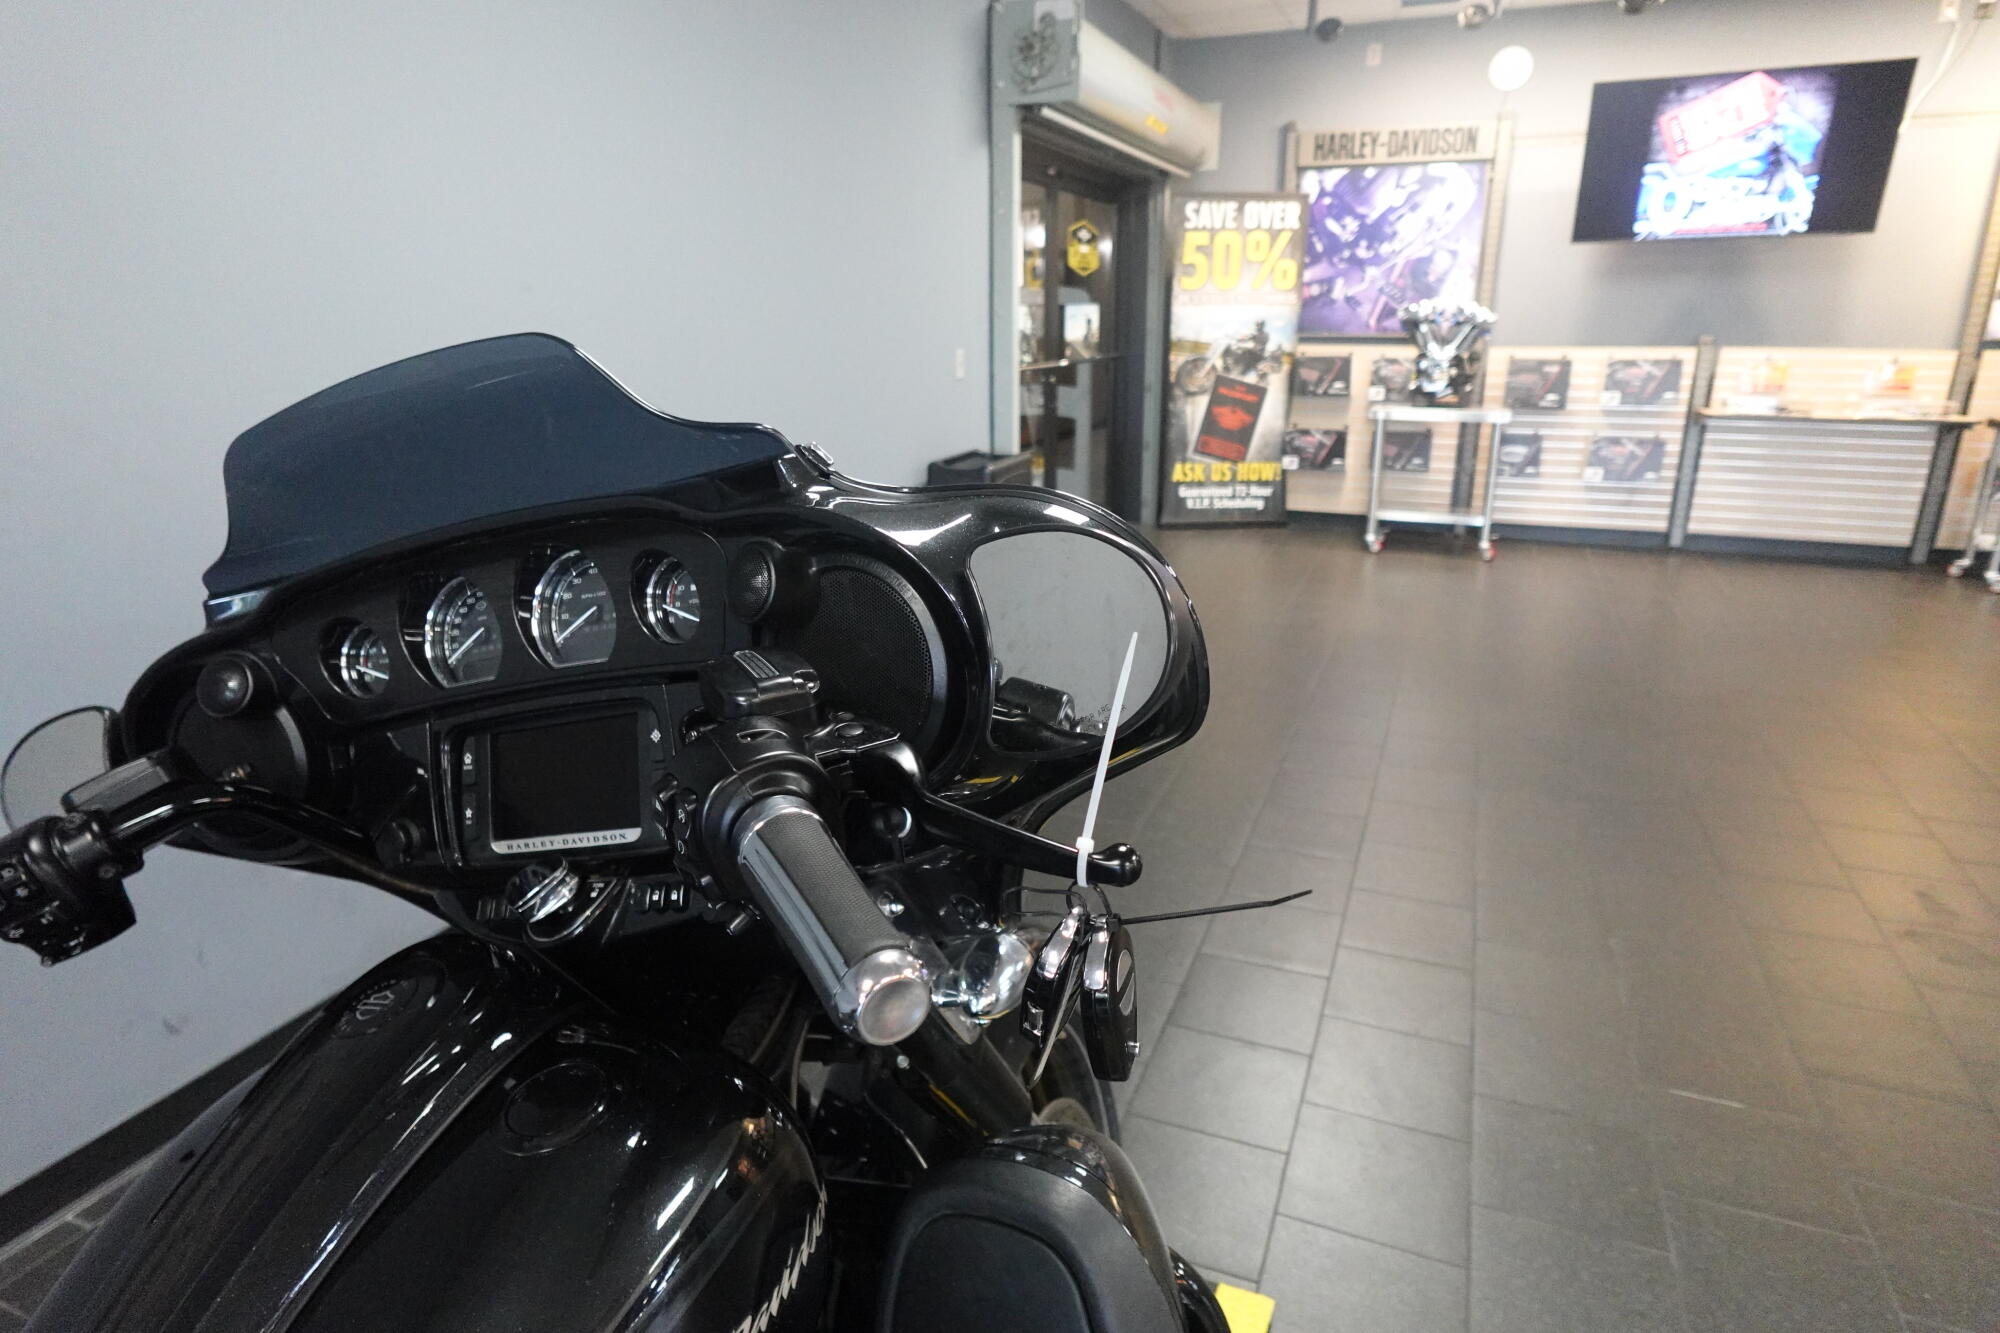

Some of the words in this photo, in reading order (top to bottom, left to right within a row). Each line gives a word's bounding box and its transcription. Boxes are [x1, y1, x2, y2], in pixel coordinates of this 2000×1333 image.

[1313, 125, 1479, 161] HARLEY-DAVIDSON
[1183, 200, 1240, 230] SAVE
[1243, 200, 1302, 230] OVER
[1179, 229, 1298, 291] 50%
[1172, 462, 1206, 482] ASK
[1210, 462, 1233, 482] US
[506, 832, 628, 852] HARLEY-DAVIDSON
